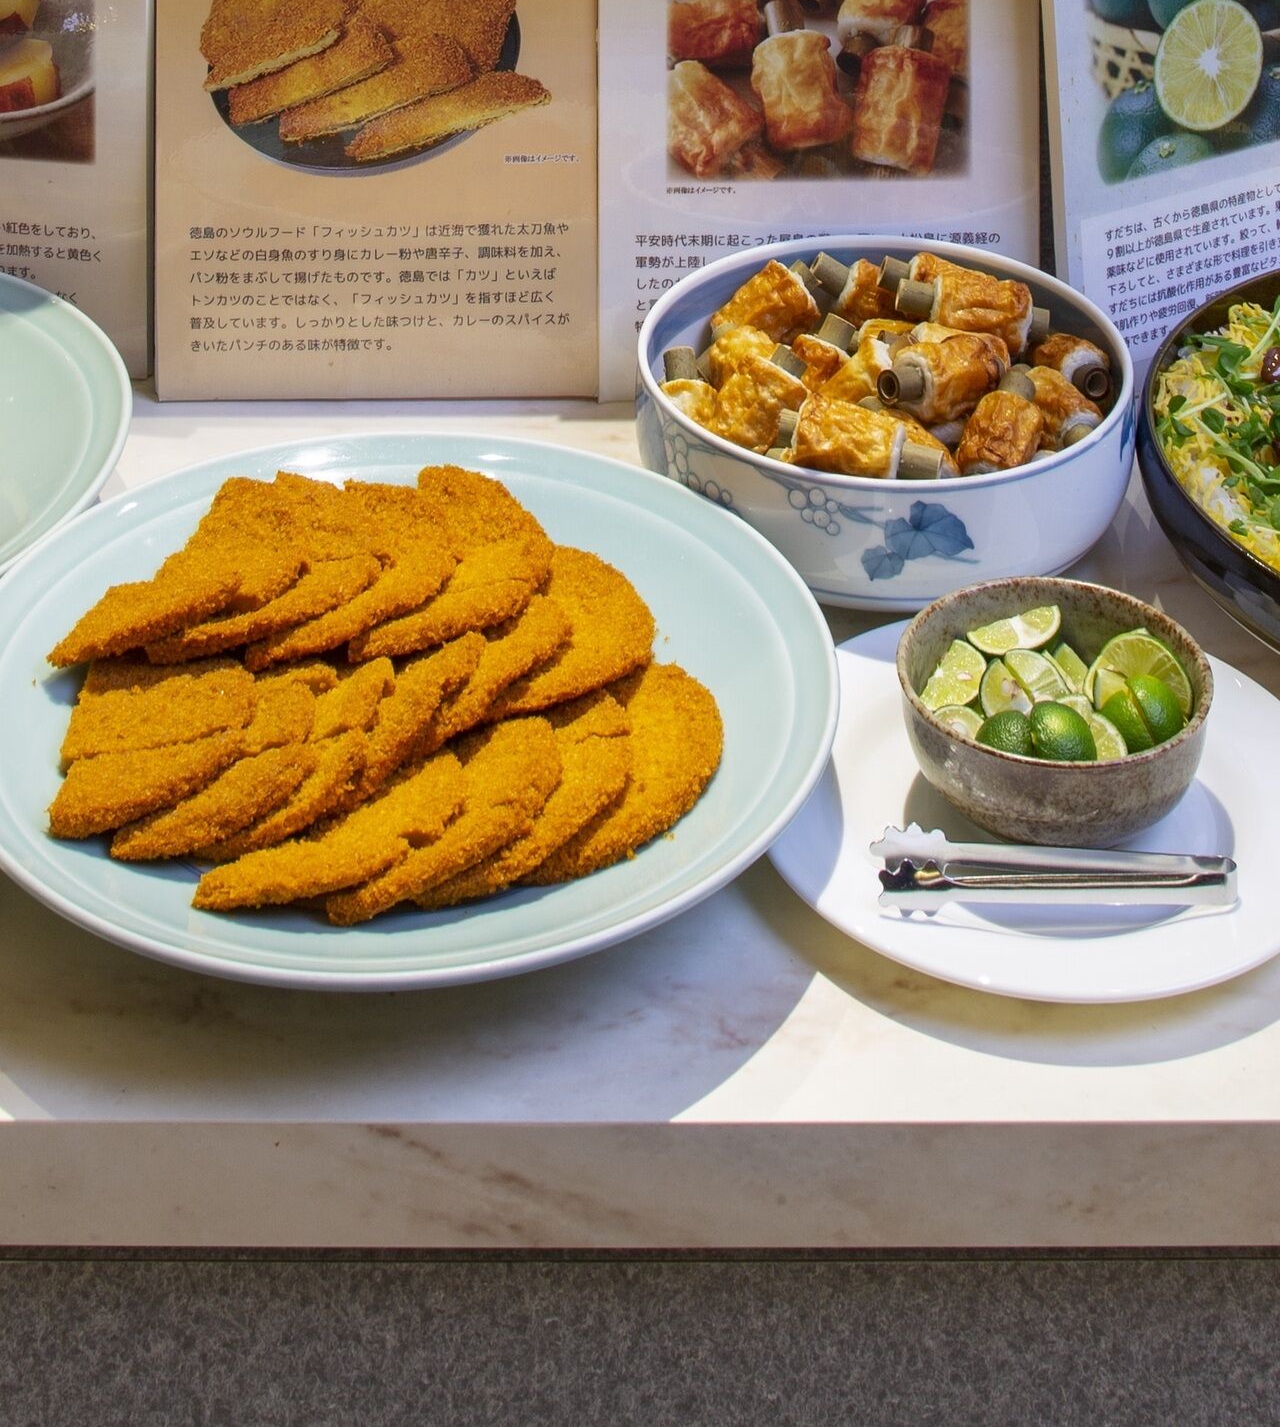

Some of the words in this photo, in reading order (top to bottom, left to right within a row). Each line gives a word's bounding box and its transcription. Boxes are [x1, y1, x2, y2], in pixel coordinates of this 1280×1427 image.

[189, 223, 569, 240] 徳島のソウルフード「フィッシュカツ」は近海で獲れた太刀魚や
[190, 245, 564, 263] エソなどの白身魚のすり身にカレー粉や唐辛子、調味料を加え、
[190, 268, 556, 285] パン粉をまぶして揚げたものです。徳島では「カツ」といえば
[636, 277, 680, 290] したの
[191, 290, 555, 307] トンカツのことではなく、「フィッシュカツ」を指すほど広く
[189, 313, 570, 330] 普及しています。しっかりとした味つけと、カレーのスパイスが
[190, 337, 393, 352] きいたパンチのある味が特徴です。
